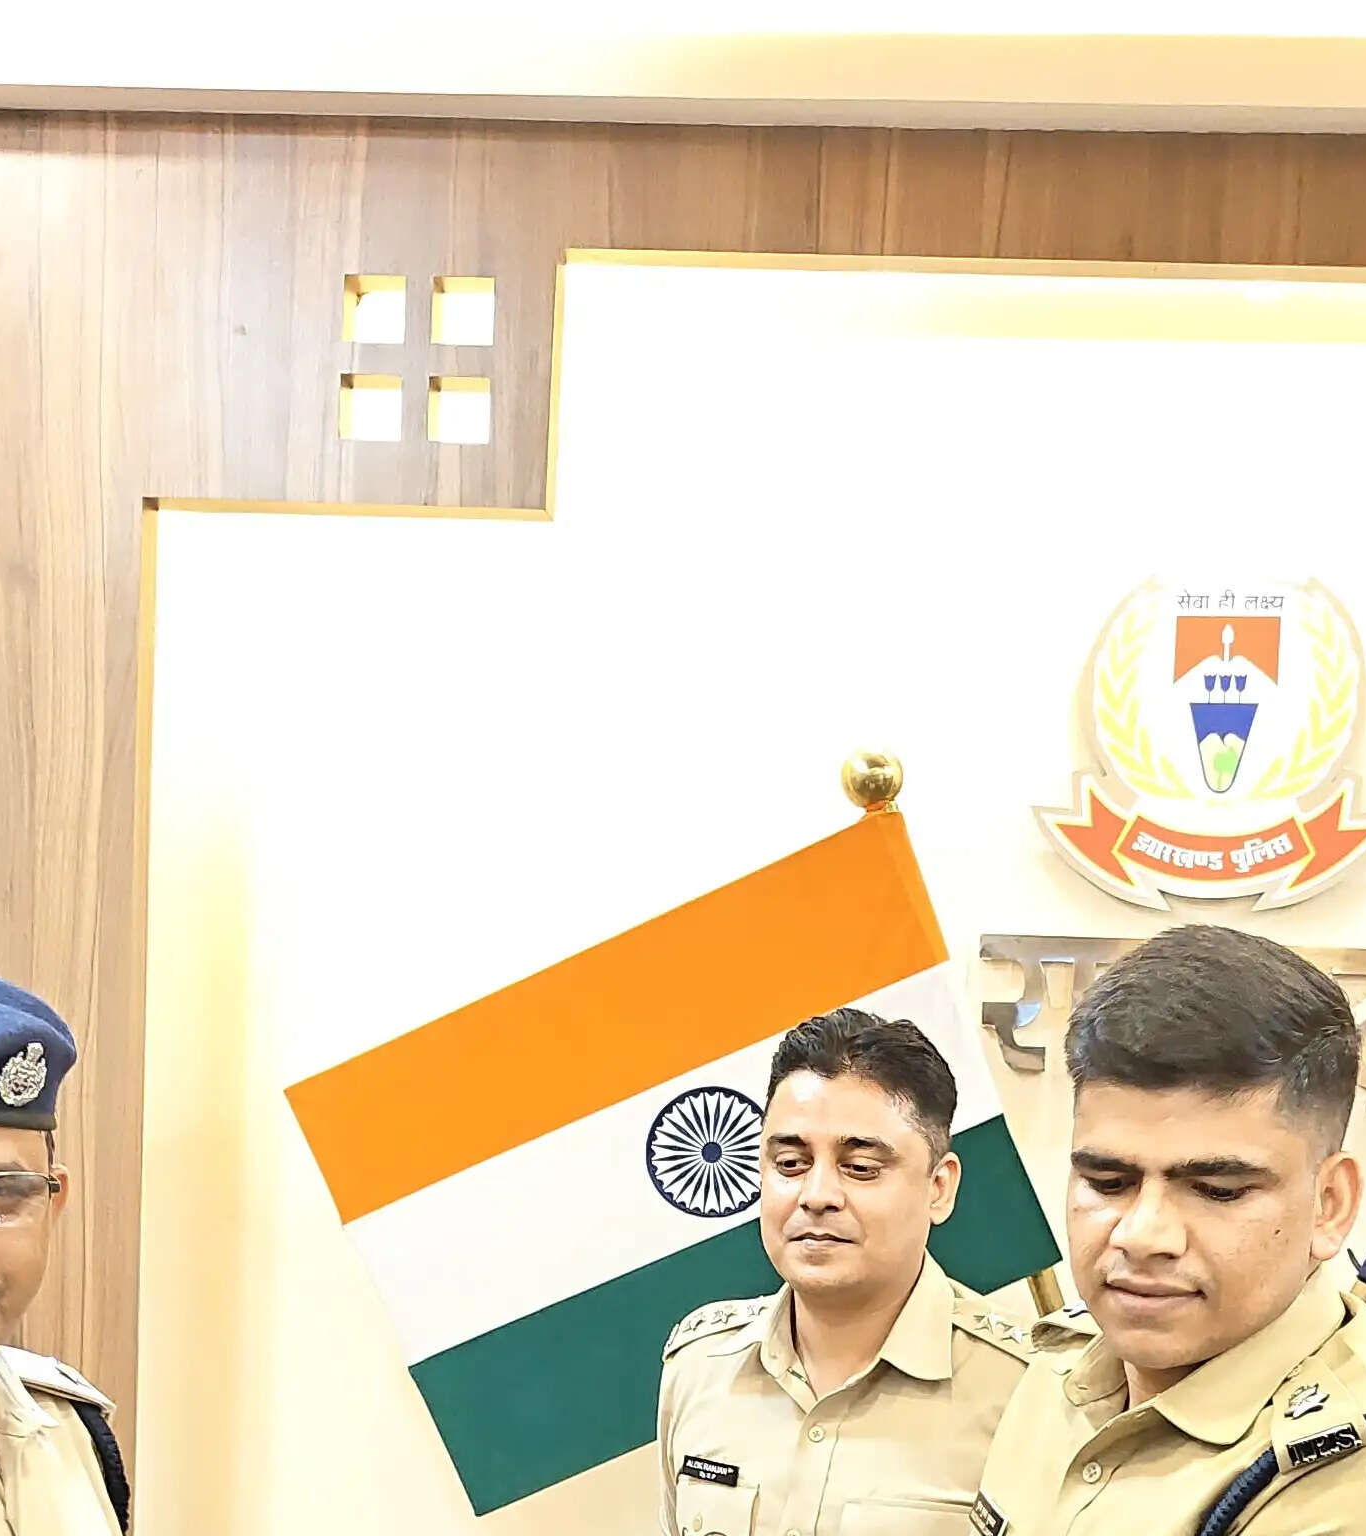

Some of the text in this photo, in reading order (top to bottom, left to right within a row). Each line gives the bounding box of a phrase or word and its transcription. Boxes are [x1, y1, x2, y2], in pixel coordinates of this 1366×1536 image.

[1177, 590, 1284, 612] सेवा ही लक्ष्य
[1230, 831, 1293, 873] पुलिस
